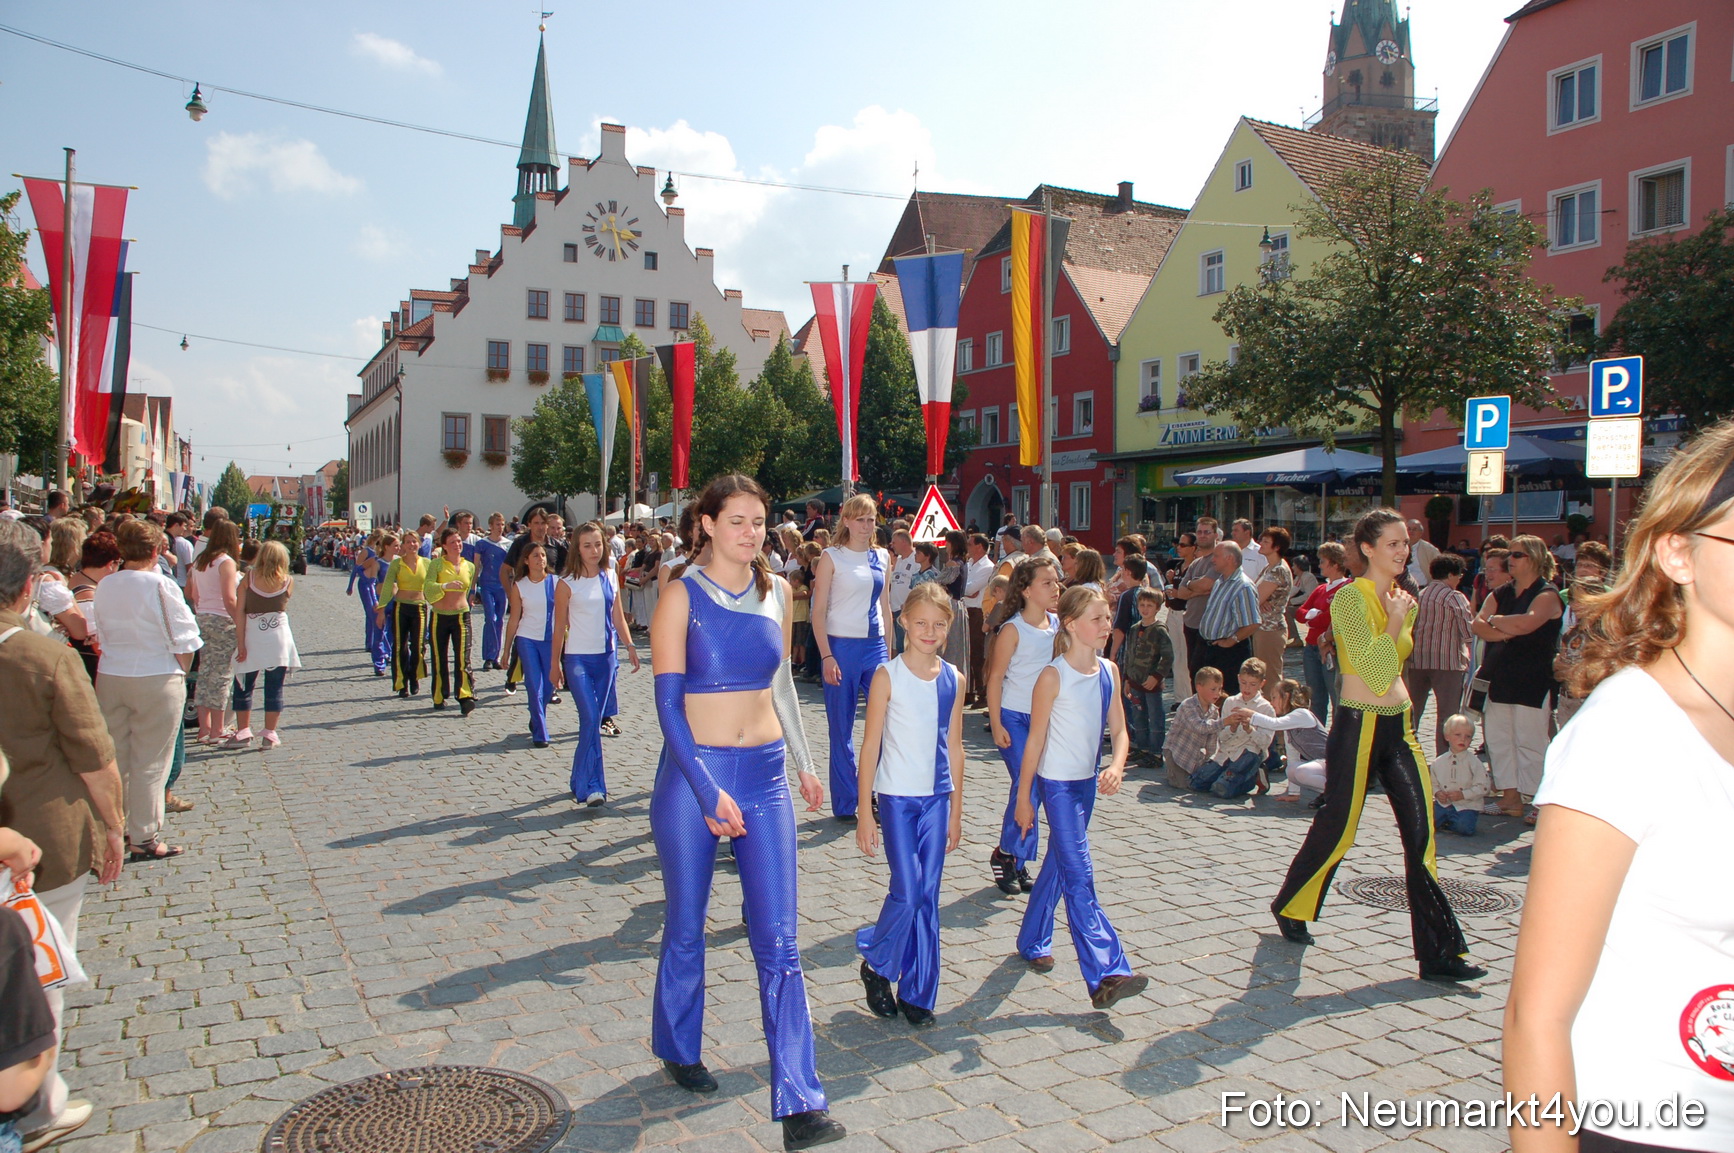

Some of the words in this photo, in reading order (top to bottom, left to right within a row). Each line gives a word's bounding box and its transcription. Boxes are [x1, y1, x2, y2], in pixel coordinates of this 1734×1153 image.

[1602, 366, 1630, 410] P
[1475, 403, 1500, 443] P
[650, 474, 656, 489] P
[1193, 476, 1227, 485] Tucher
[1274, 473, 1311, 482] Tucher
[259, 615, 280, 631] 86
[1710, 1002, 1731, 1012] Rock
[1723, 1012, 1734, 1022] Cl
